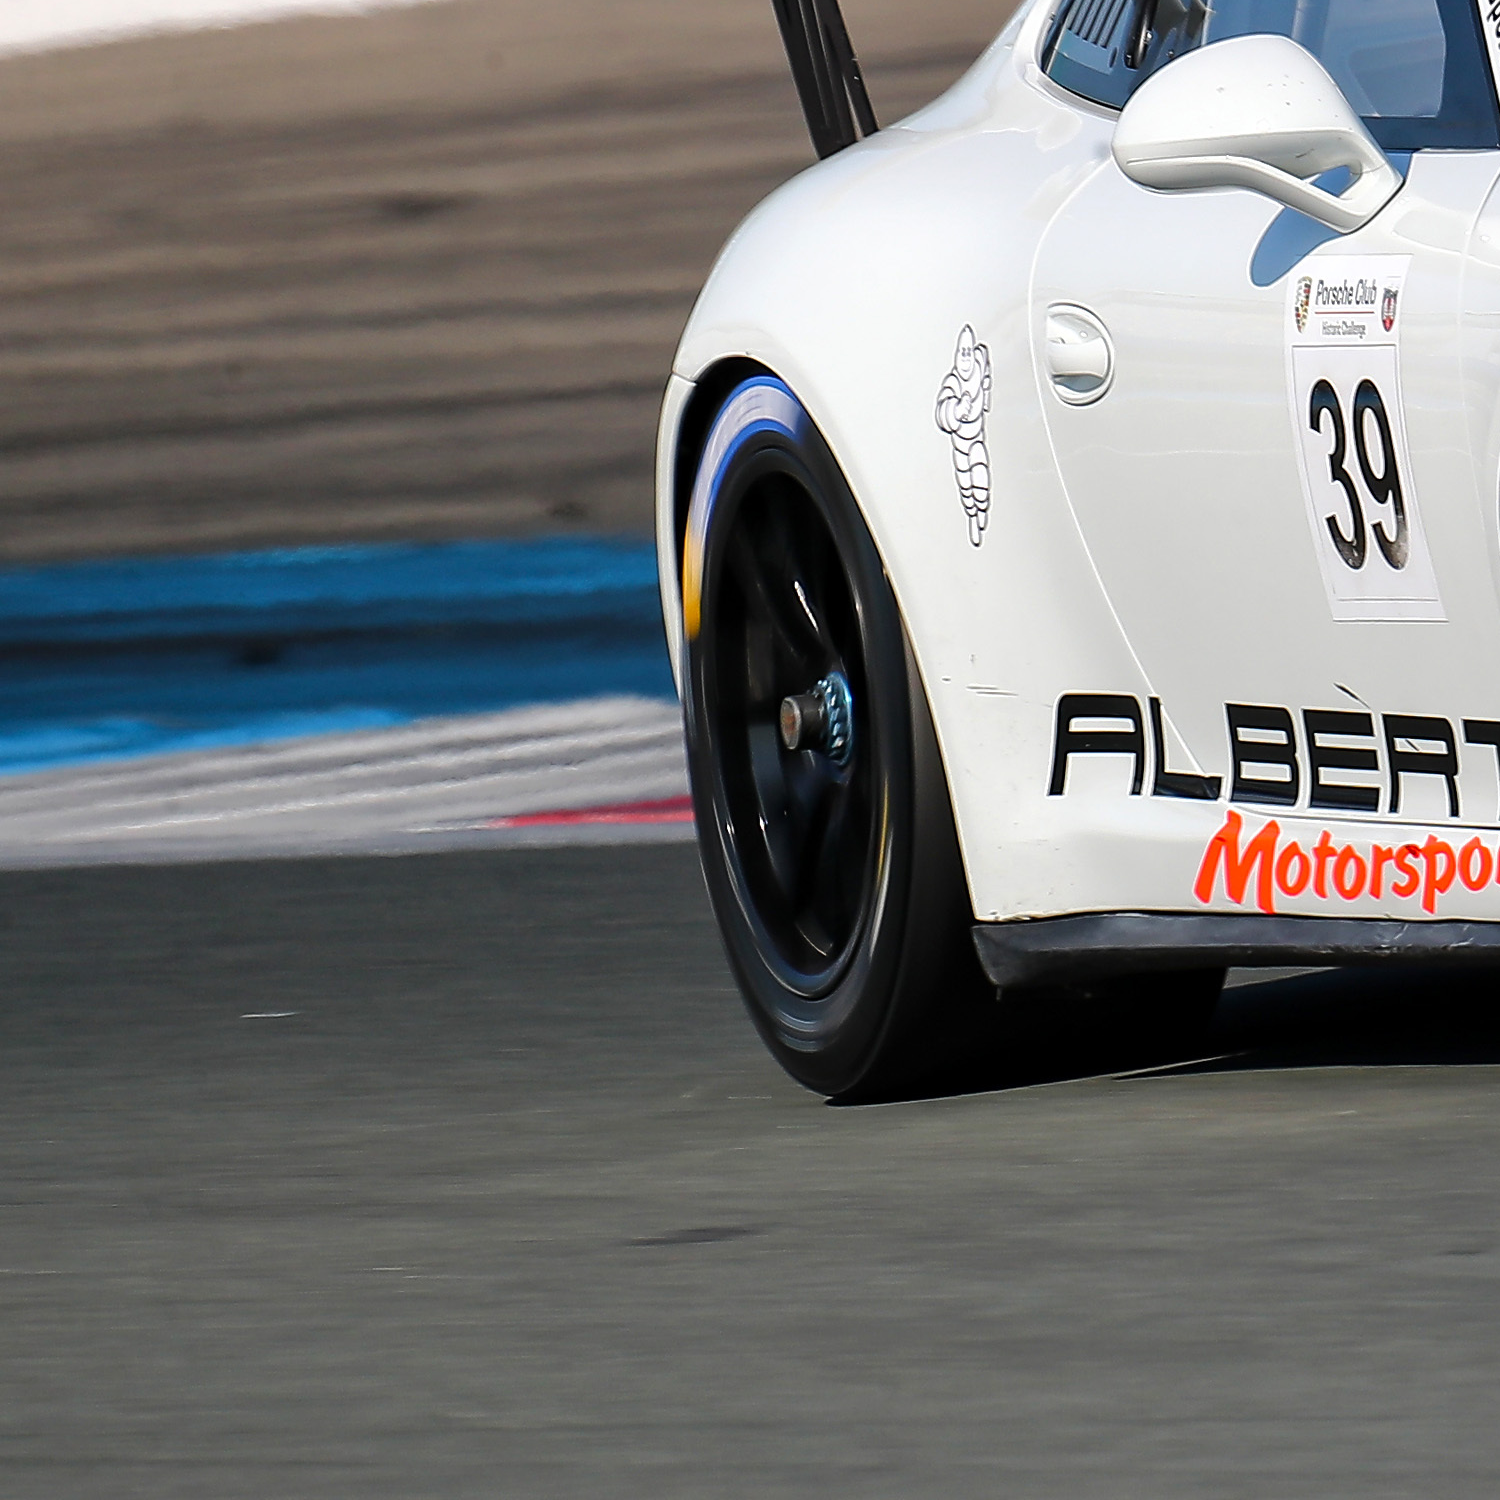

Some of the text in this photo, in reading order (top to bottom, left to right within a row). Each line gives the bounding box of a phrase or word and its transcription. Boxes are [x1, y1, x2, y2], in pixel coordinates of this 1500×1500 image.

[1315, 278, 1378, 306] Porsche Club
[1309, 377, 1410, 570] 39
